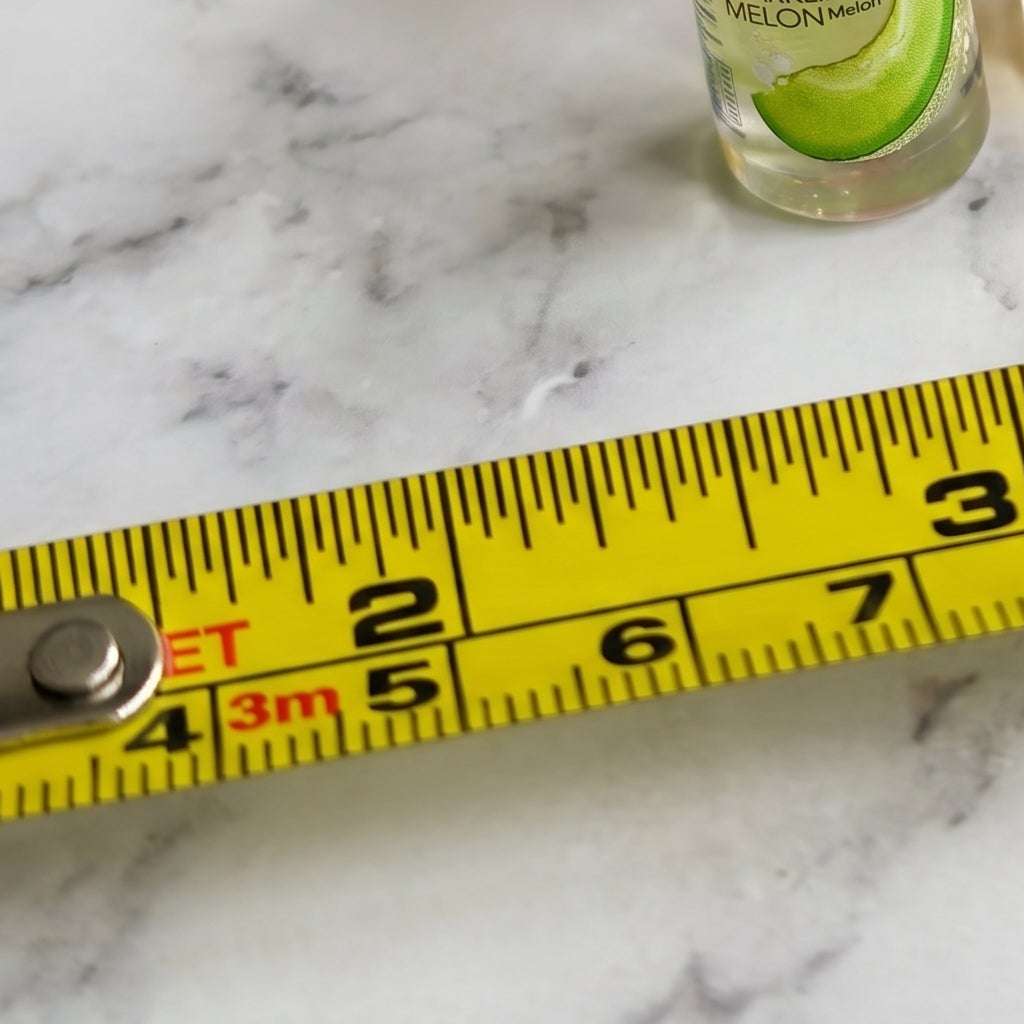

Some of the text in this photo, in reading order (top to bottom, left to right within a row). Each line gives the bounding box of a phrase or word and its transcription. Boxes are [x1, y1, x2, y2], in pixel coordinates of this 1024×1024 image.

[925, 469, 1018, 537] 3
[349, 576, 446, 649] 2
[825, 571, 895, 625] 7
[600, 616, 676, 667] 6
[228, 686, 340, 732] 3m
[367, 660, 440, 712] 5
[124, 705, 203, 753] 4
